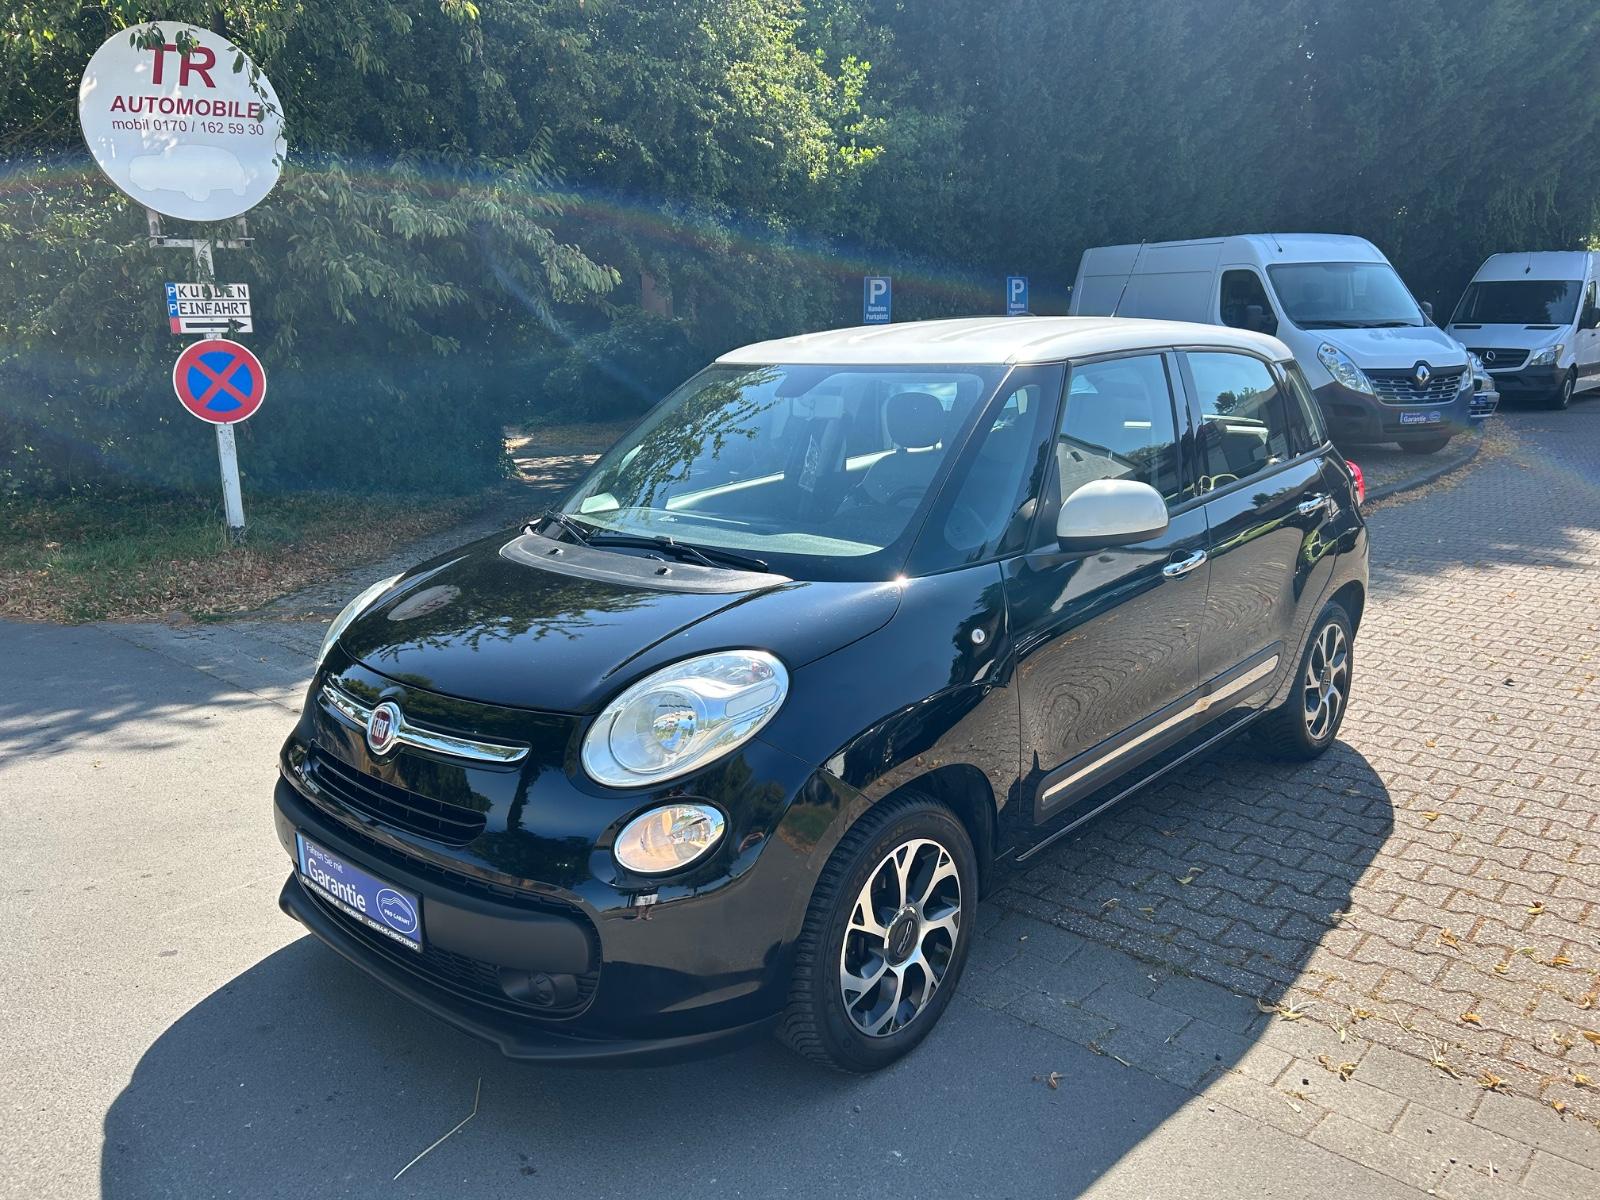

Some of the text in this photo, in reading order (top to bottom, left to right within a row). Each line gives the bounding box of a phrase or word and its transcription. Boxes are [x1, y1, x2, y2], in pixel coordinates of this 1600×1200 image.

[148, 44, 216, 88] TR
[110, 95, 263, 119] AUTOMOBILE
[112, 119, 150, 131] mobil
[153, 119, 187, 132] 0170
[200, 121, 225, 134] 162
[228, 122, 244, 135] 59
[248, 123, 264, 136] 30
[178, 286, 247, 298] KUDN
[869, 279, 887, 304] P
[1011, 279, 1025, 302] P
[180, 303, 247, 314] EINFAHRT
[324, 853, 333, 867] Sie
[308, 858, 366, 913] Garantie
